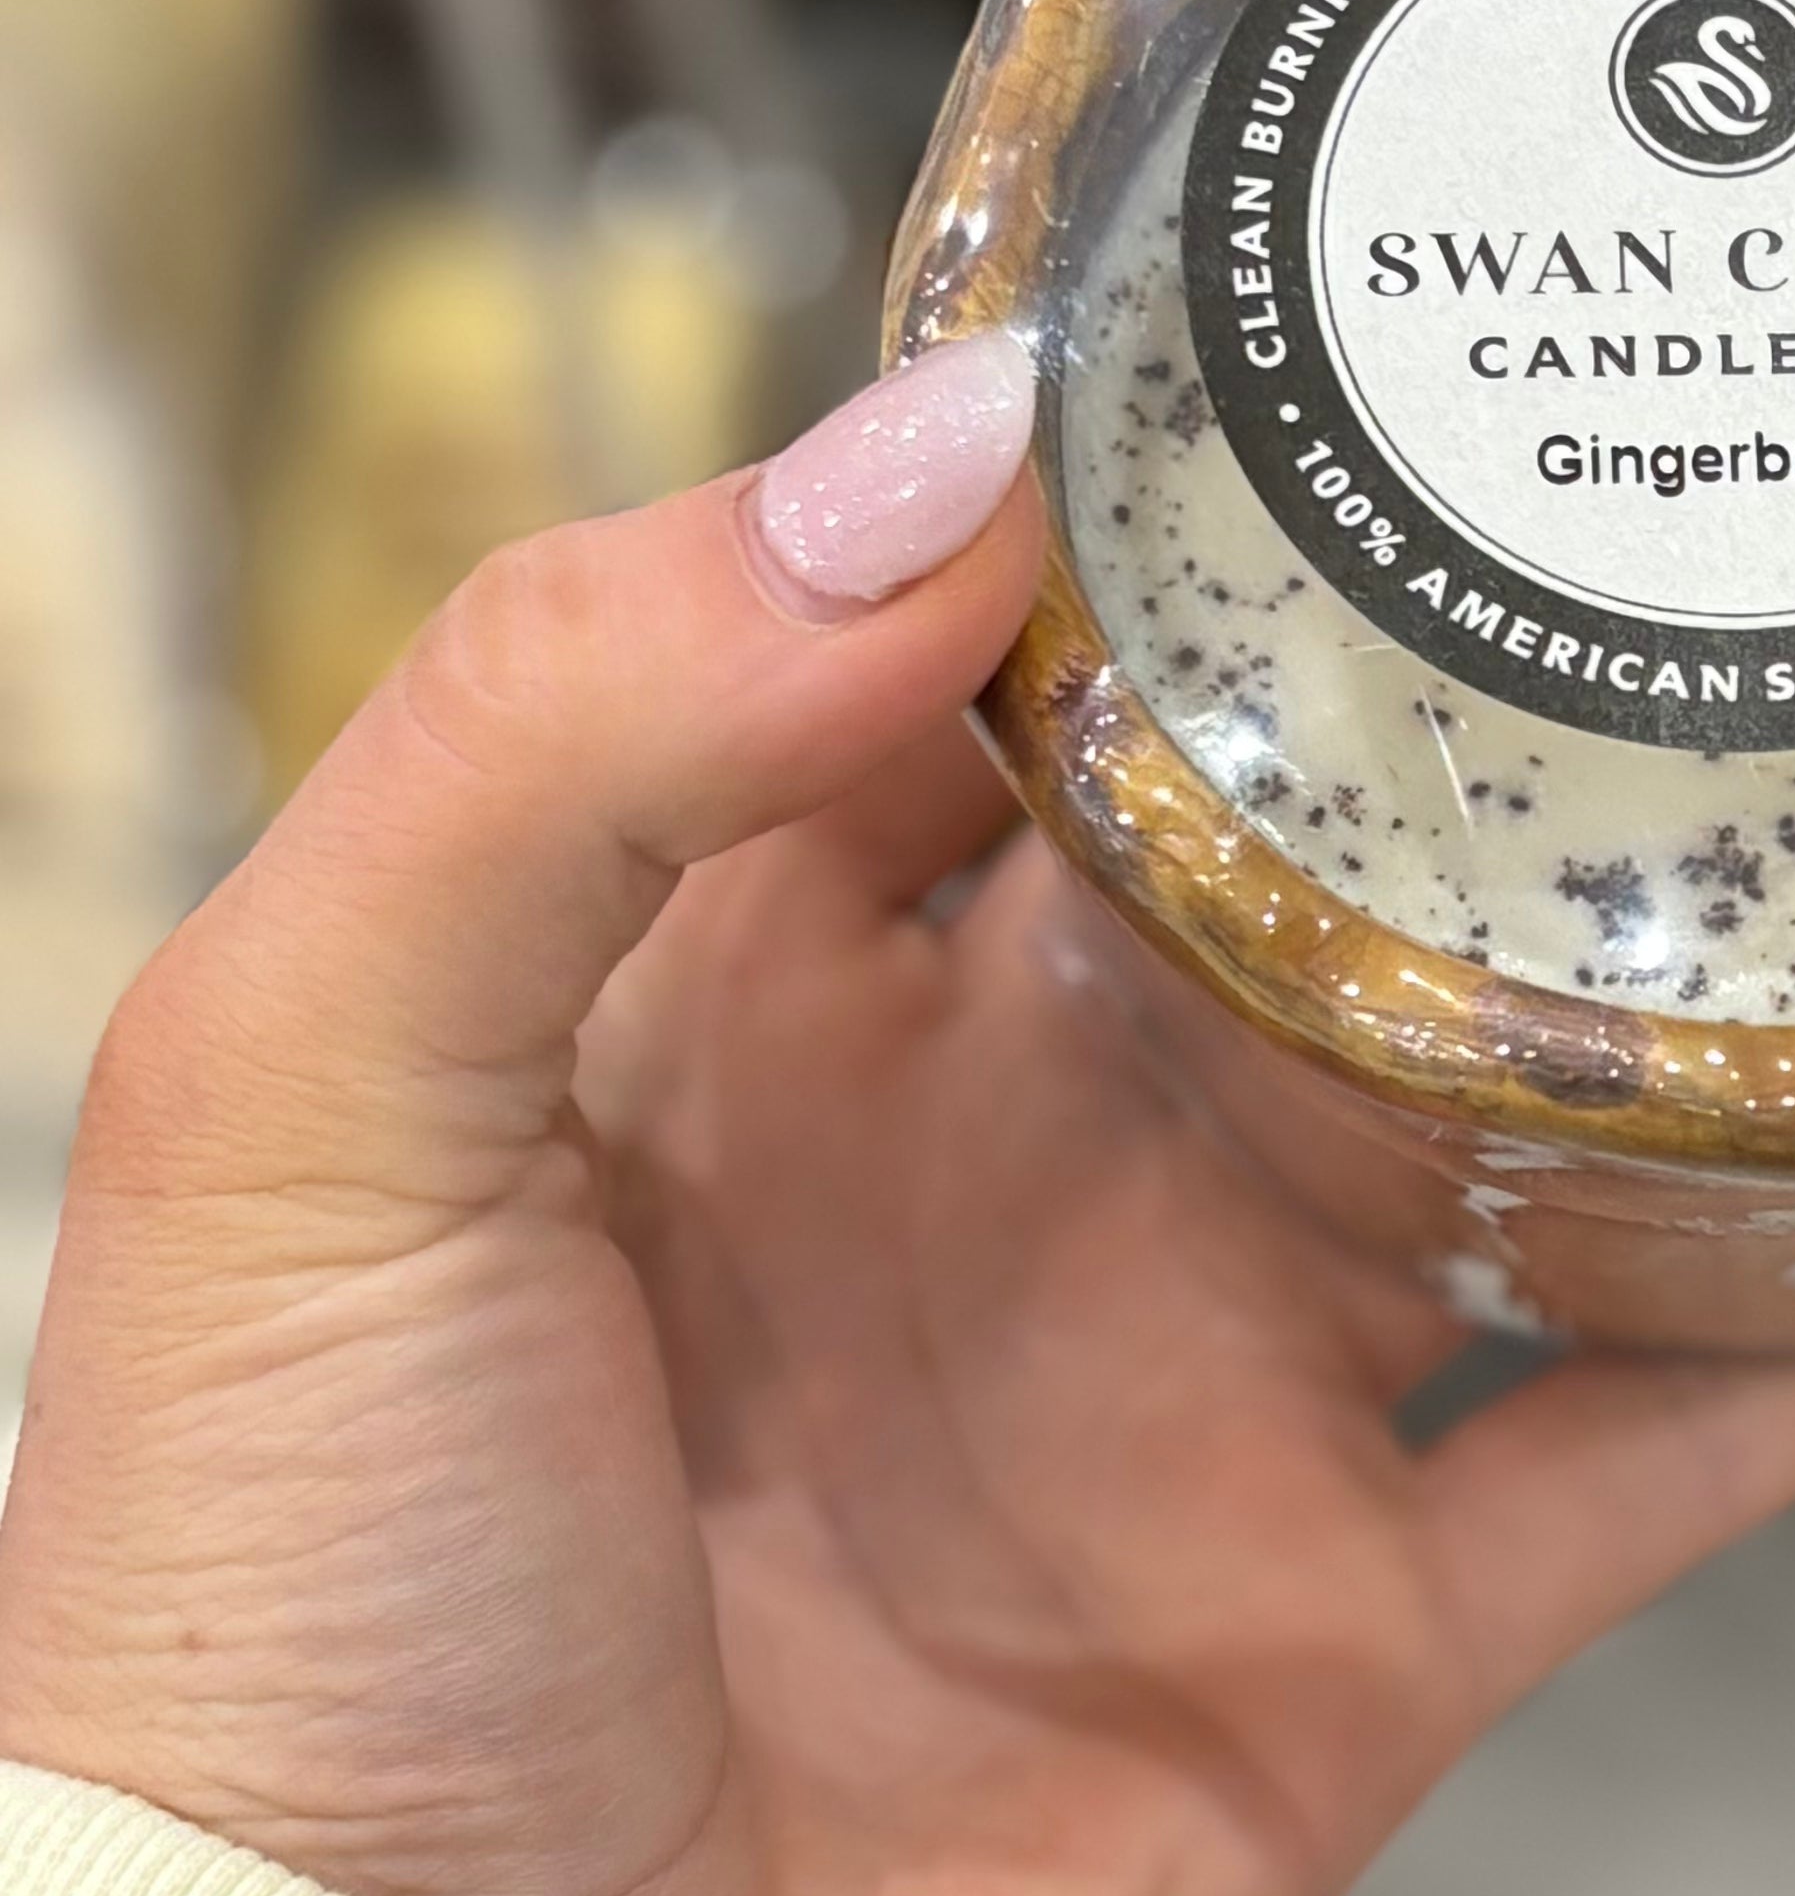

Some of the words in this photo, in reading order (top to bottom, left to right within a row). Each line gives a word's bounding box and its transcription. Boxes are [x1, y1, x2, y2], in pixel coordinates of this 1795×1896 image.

[1231, 175, 1286, 369] CLEAN
[1367, 230, 1675, 297] SWAN
[1295, 440, 1406, 566] 100%
[1405, 567, 1740, 703] AMERICAN
